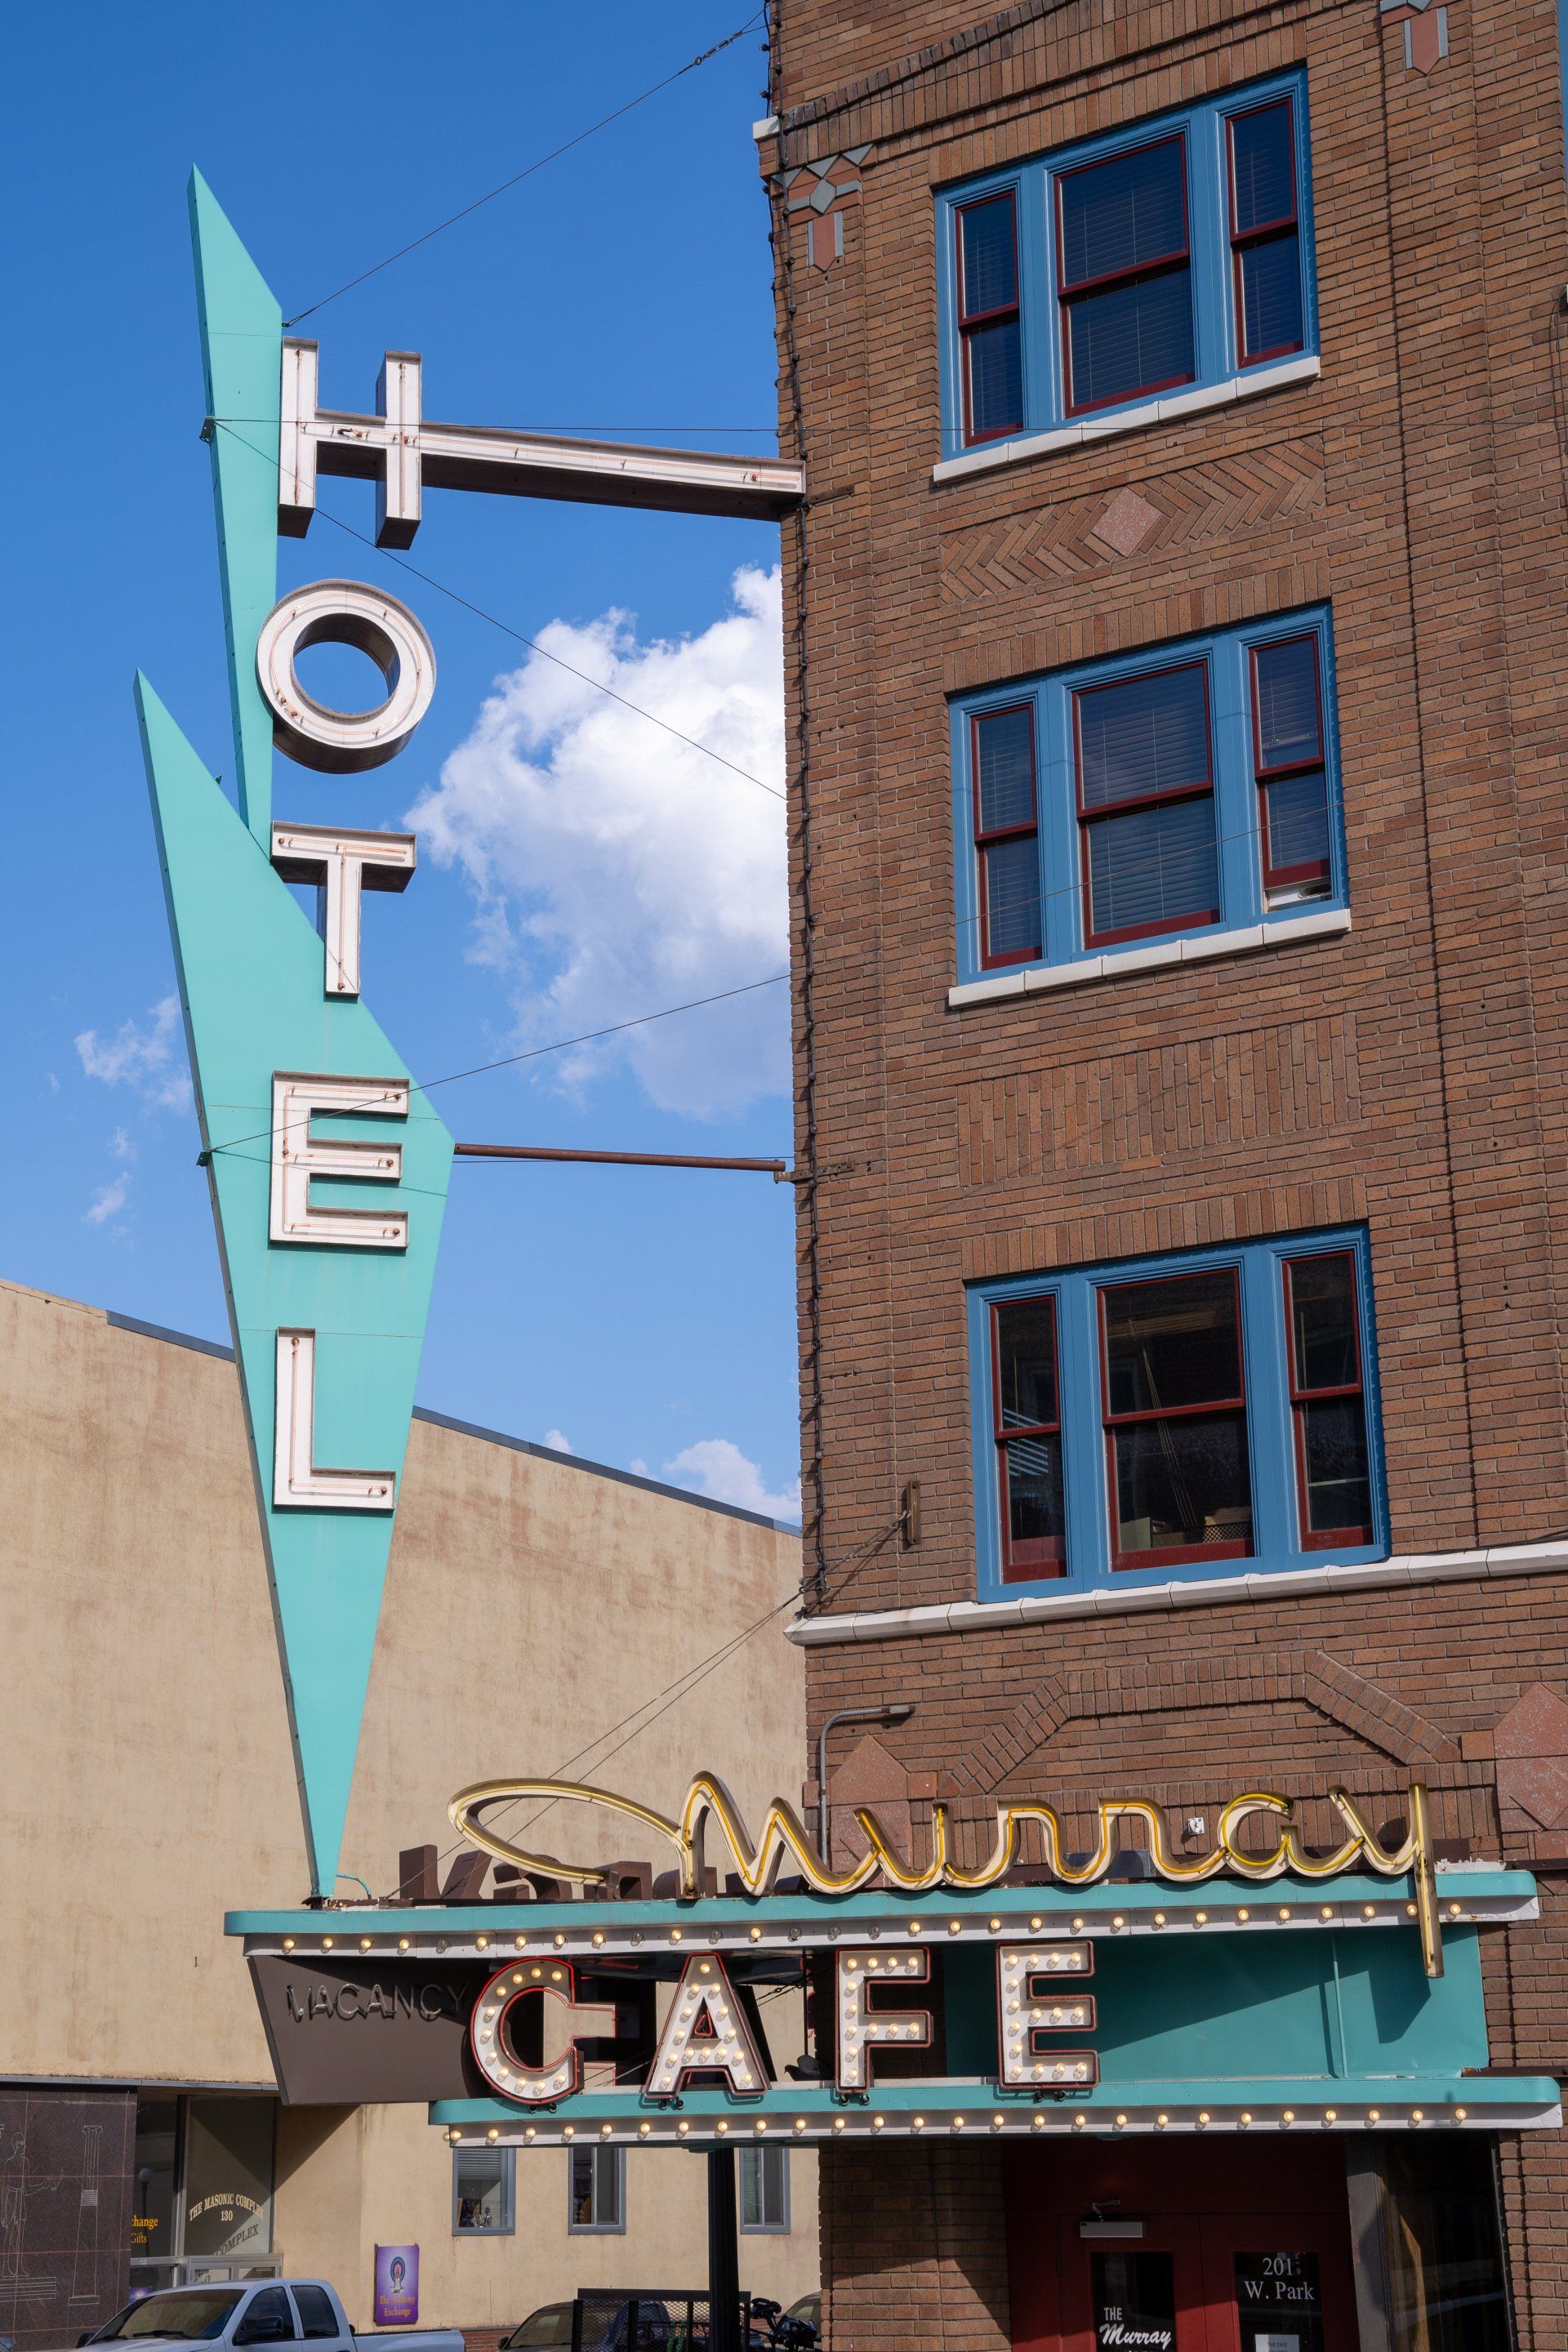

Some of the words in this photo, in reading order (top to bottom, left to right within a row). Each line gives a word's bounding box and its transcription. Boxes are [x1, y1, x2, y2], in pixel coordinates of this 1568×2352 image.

[256, 336, 437, 1510] HOTEL
[448, 1771, 1444, 1977] Murray
[284, 1981, 469, 2023] VACANCY
[470, 1940, 1100, 2105] CAFE
[189, 2203, 203, 2221] THE
[204, 2194, 234, 2211] MASONIC
[235, 2194, 265, 2221] COMPLEX
[220, 2210, 234, 2221] 130
[1262, 2257, 1293, 2276] 201
[1244, 2280, 1269, 2300] W.
[1274, 2281, 1316, 2300] Park
[384, 2308, 411, 2317] Exchange
[1103, 2306, 1123, 2321] THE
[1099, 2323, 1172, 2350] Murray
